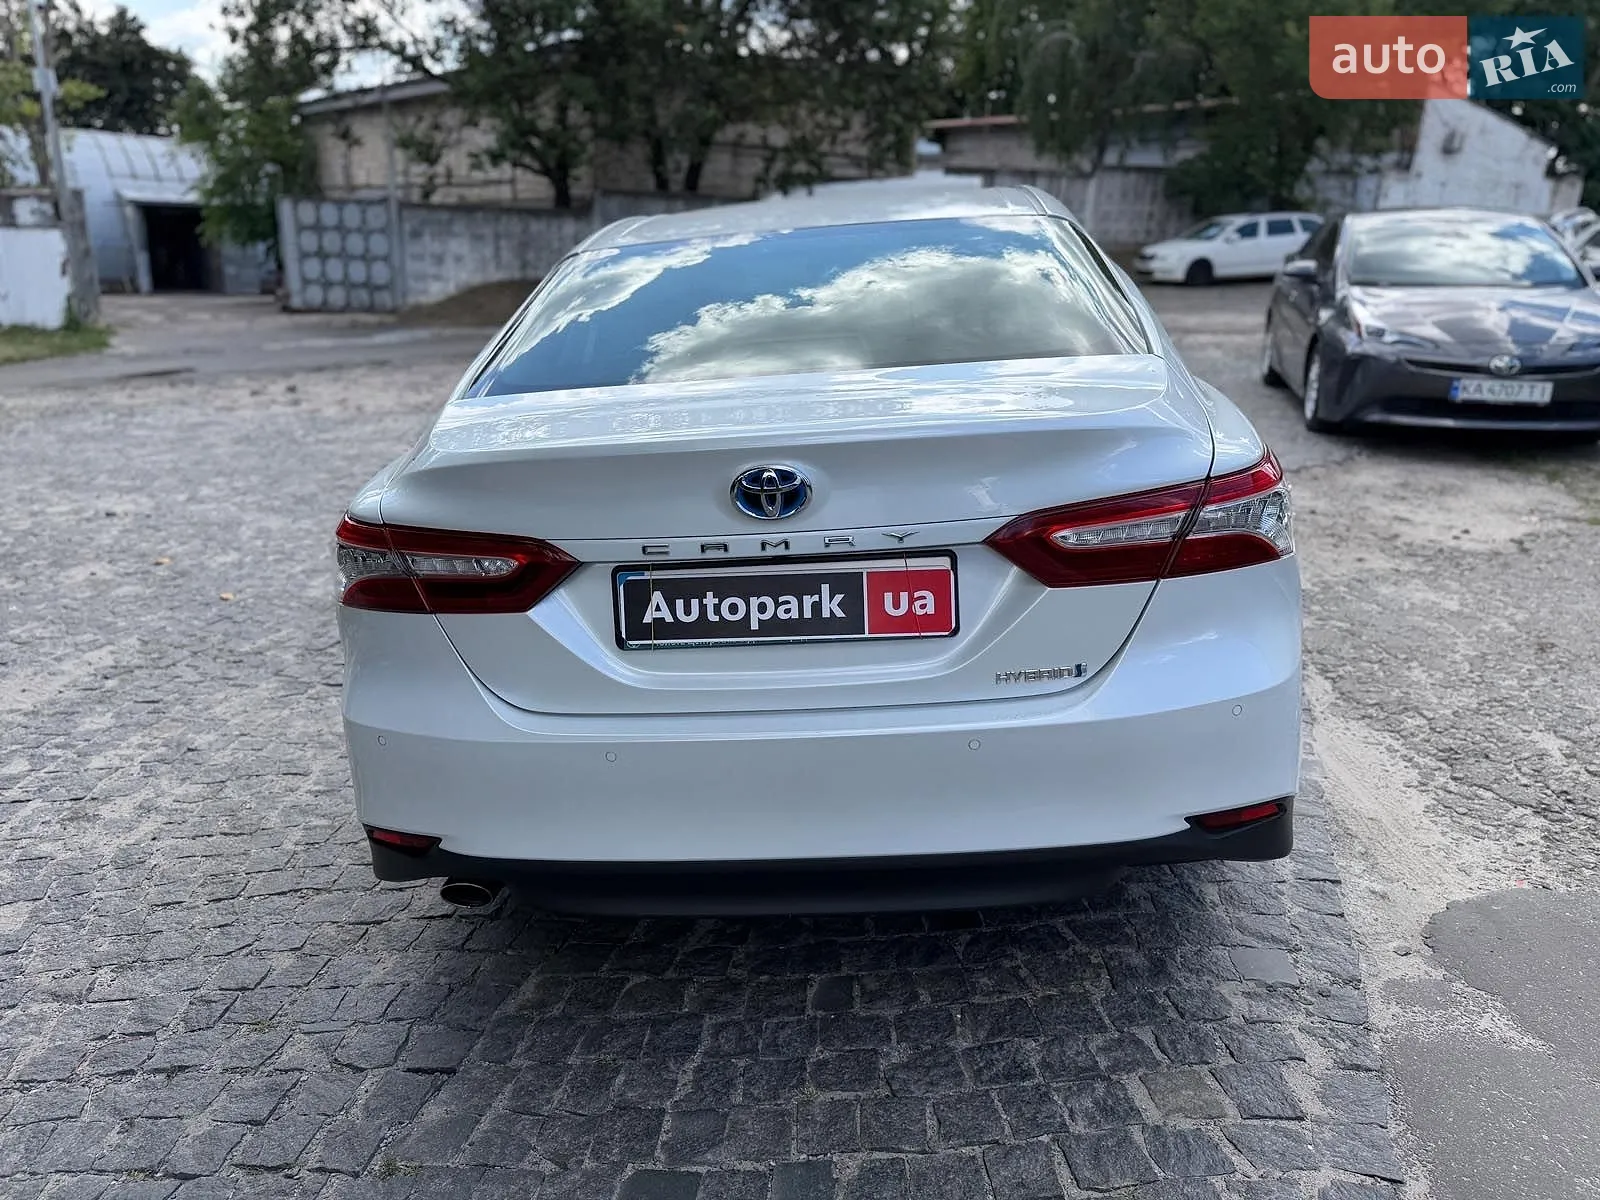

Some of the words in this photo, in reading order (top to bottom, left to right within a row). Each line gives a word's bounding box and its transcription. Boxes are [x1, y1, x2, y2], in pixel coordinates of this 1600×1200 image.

[642, 530, 920, 555] CAMRY
[642, 583, 846, 631] Autopark
[884, 589, 936, 617] ua
[995, 666, 1074, 684] HYBRID
